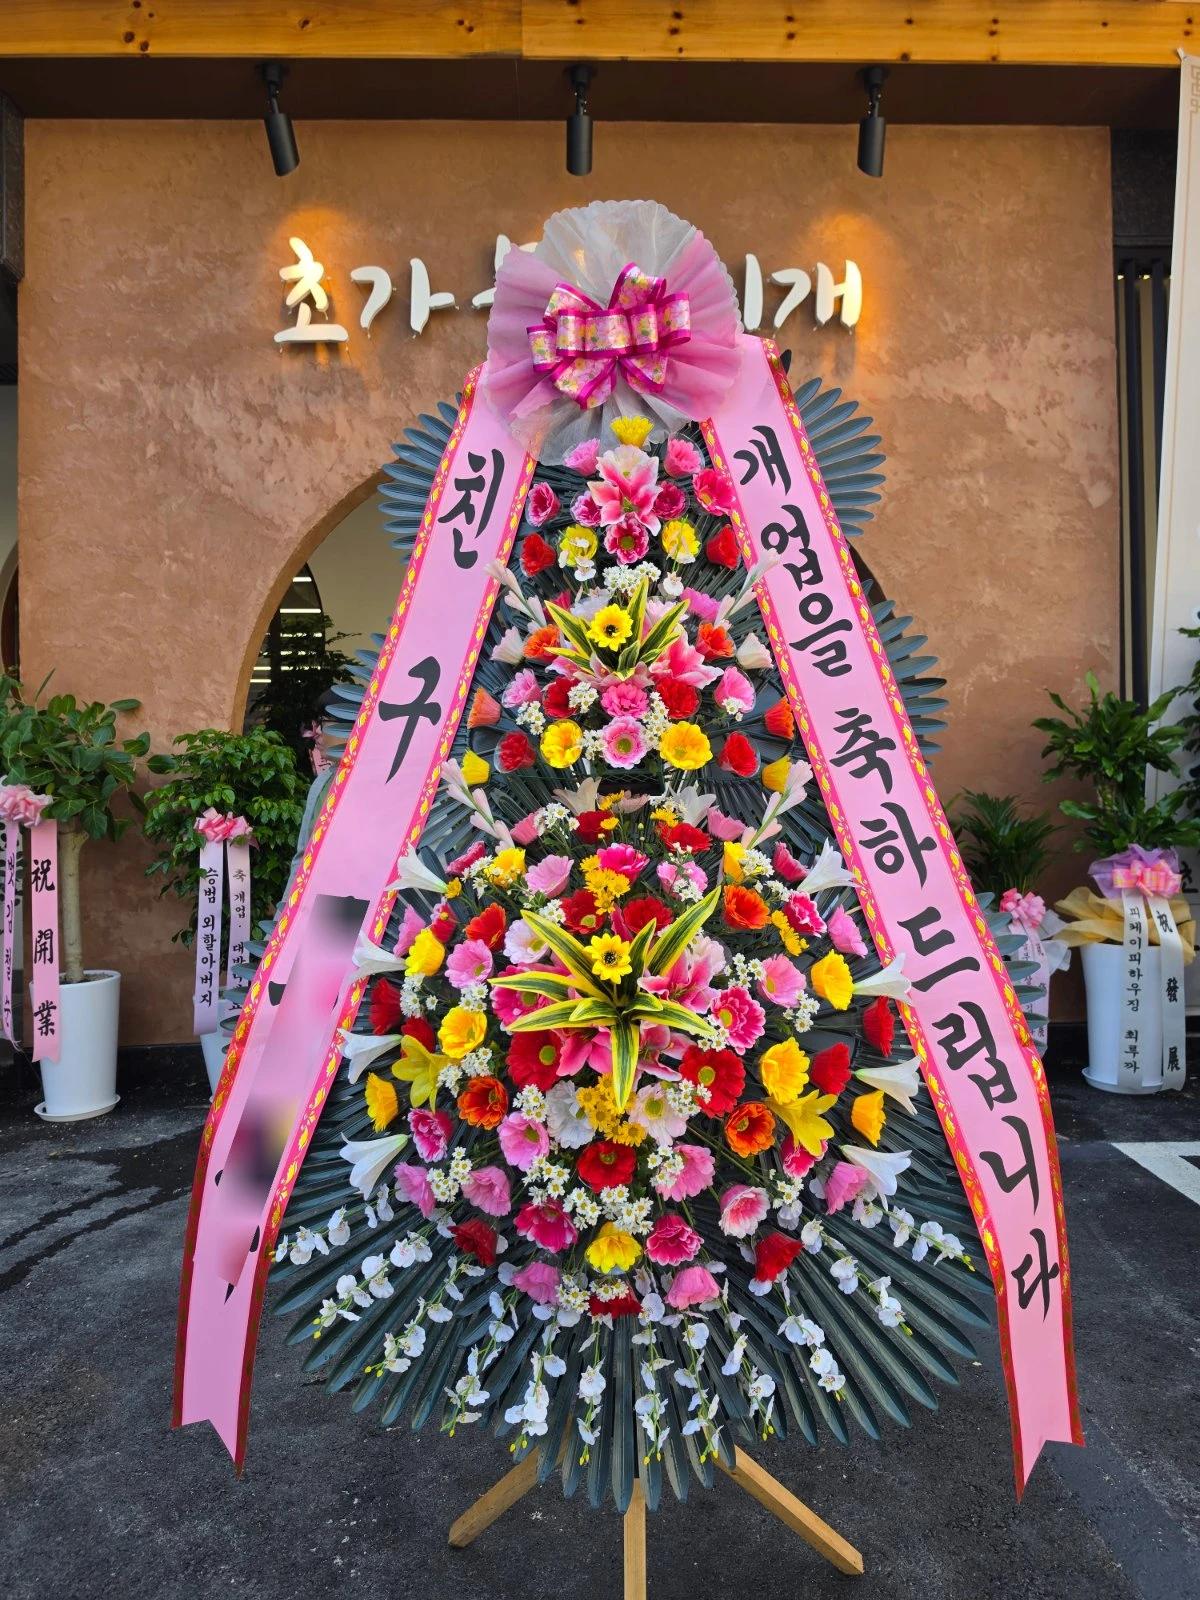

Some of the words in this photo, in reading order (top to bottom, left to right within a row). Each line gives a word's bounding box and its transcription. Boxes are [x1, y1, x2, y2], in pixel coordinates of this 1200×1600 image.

[378, 448, 506, 785] 친구
[199, 914, 217, 1008] 외할아버지
[732, 425, 854, 678] 개업을
[829, 706, 1060, 1323] 축하드립니다
[1126, 906, 1143, 1012] 피케이피하우징
